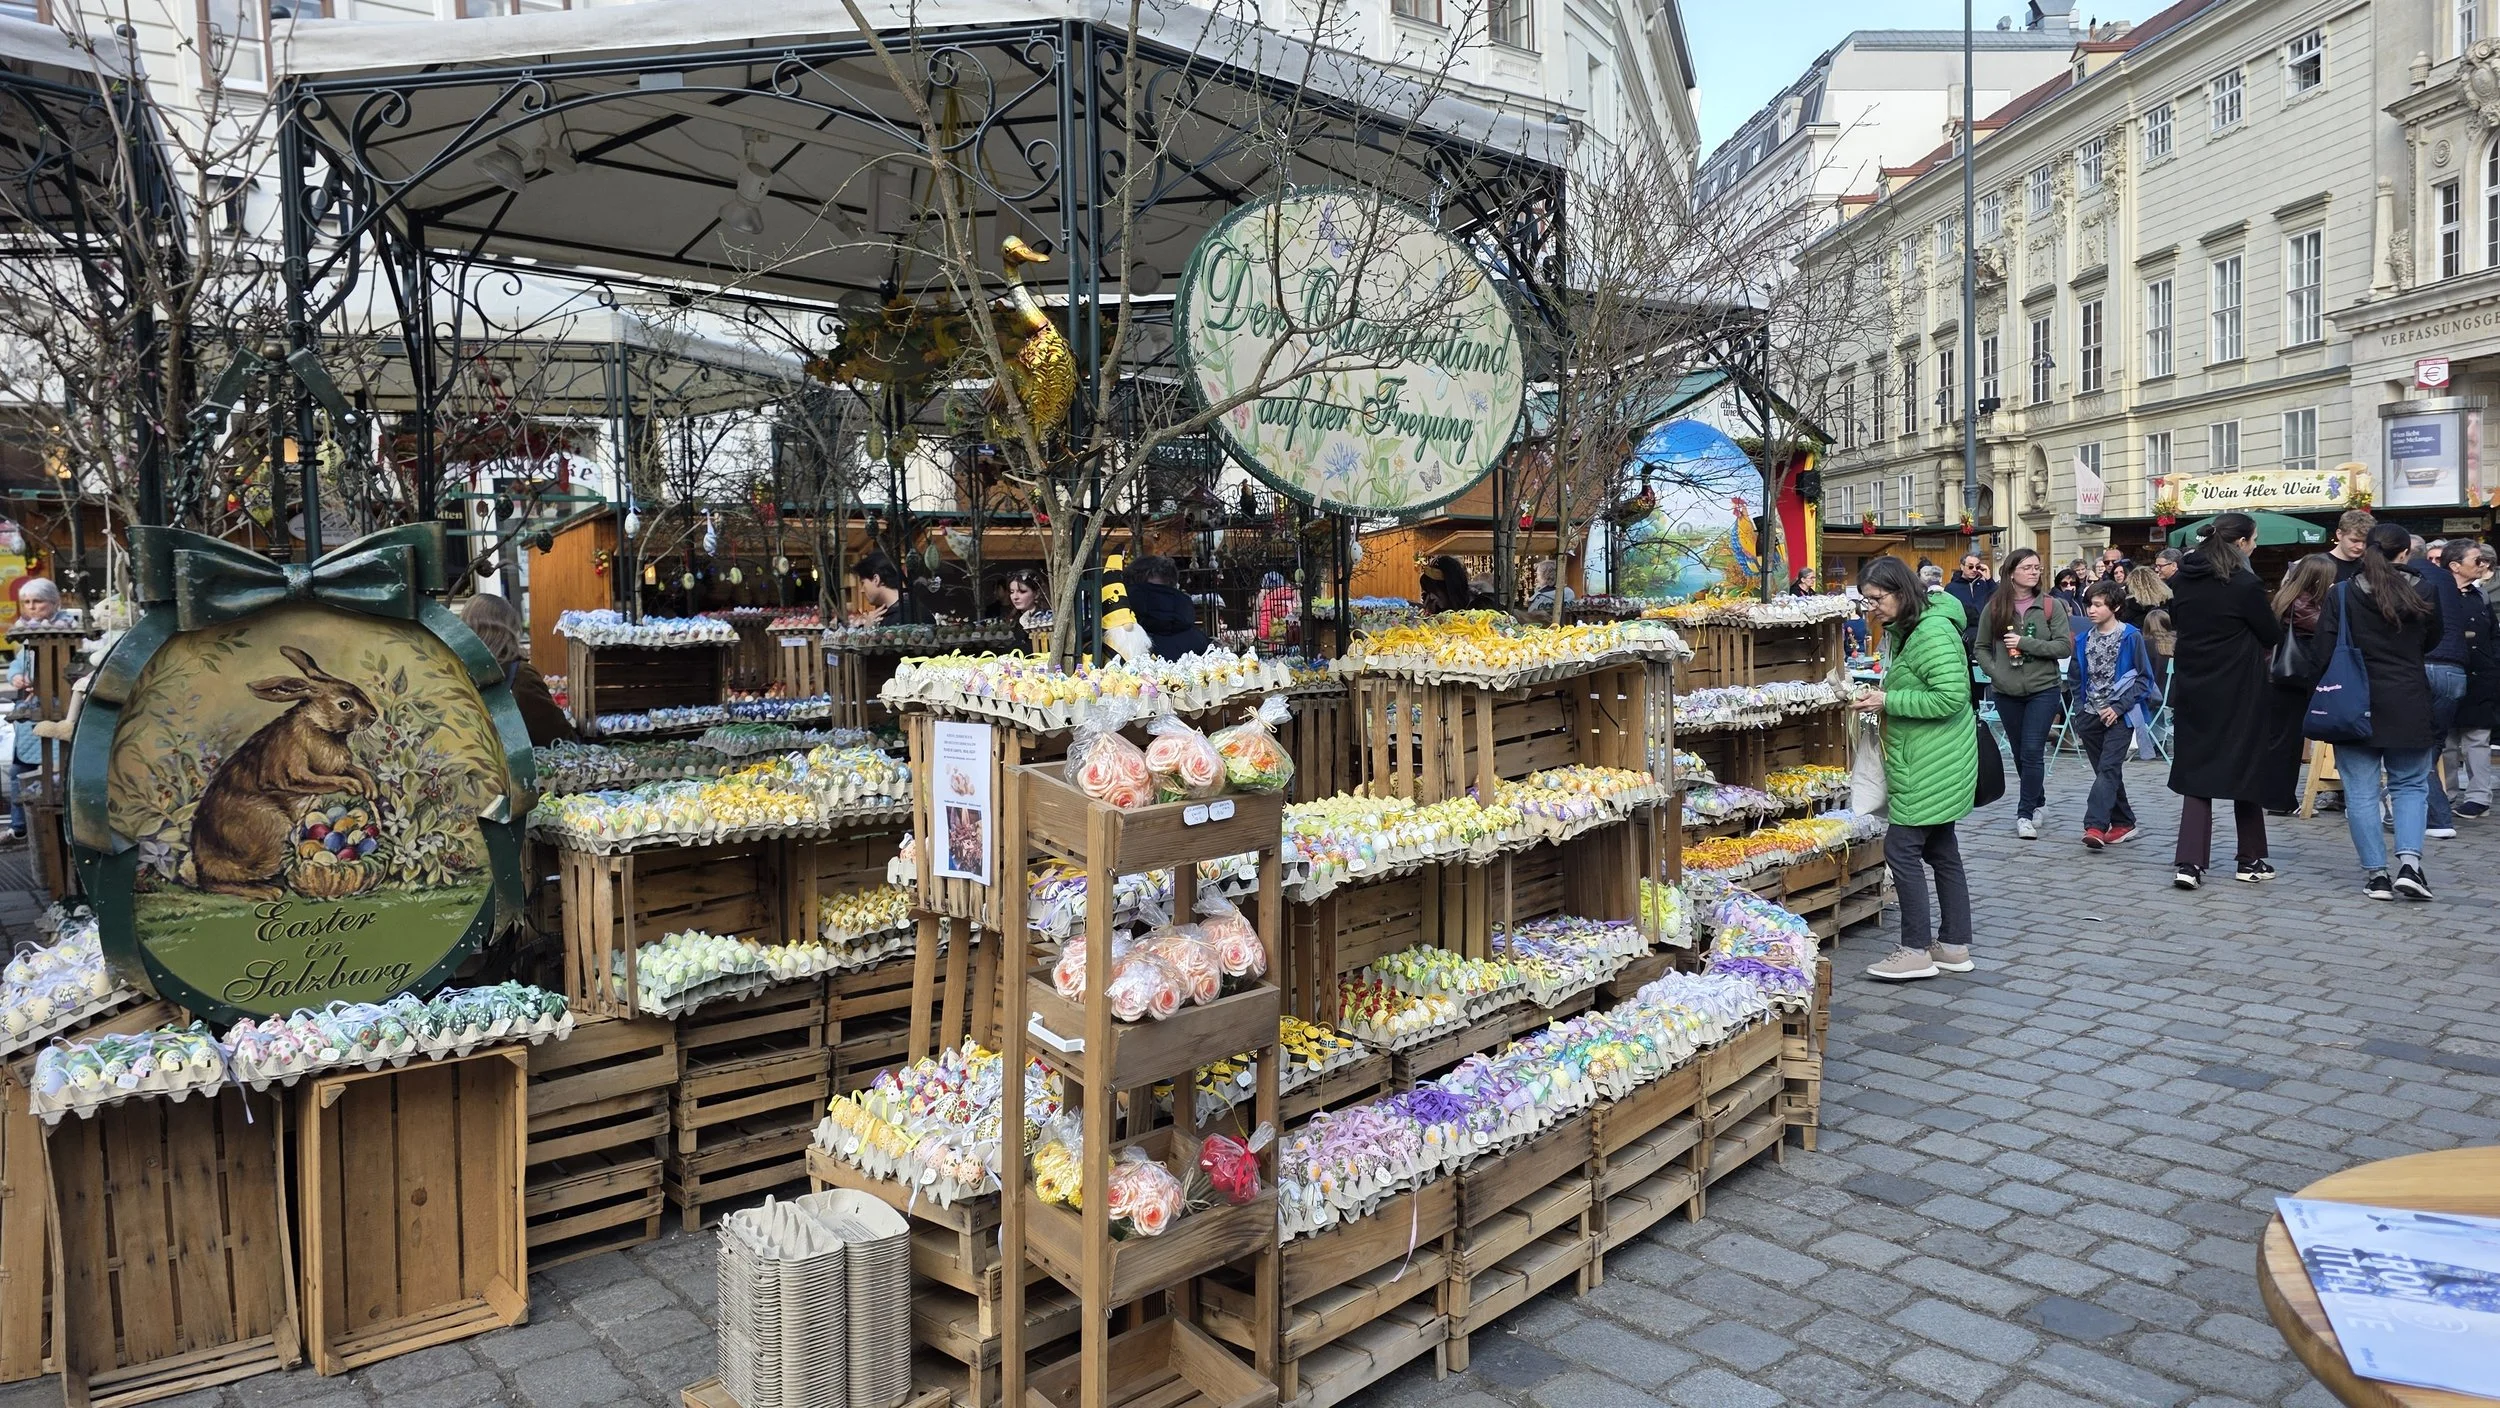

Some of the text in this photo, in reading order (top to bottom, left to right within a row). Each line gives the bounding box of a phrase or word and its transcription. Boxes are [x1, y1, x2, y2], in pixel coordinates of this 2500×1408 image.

[1202, 237, 1287, 339] Der
[1258, 374, 1473, 466] auf der Freyung
[2201, 481, 2322, 499] Wein 4tler Wein
[254, 900, 377, 946] Easter
[304, 937, 345, 960] in
[221, 956, 414, 1004] Salzburg
